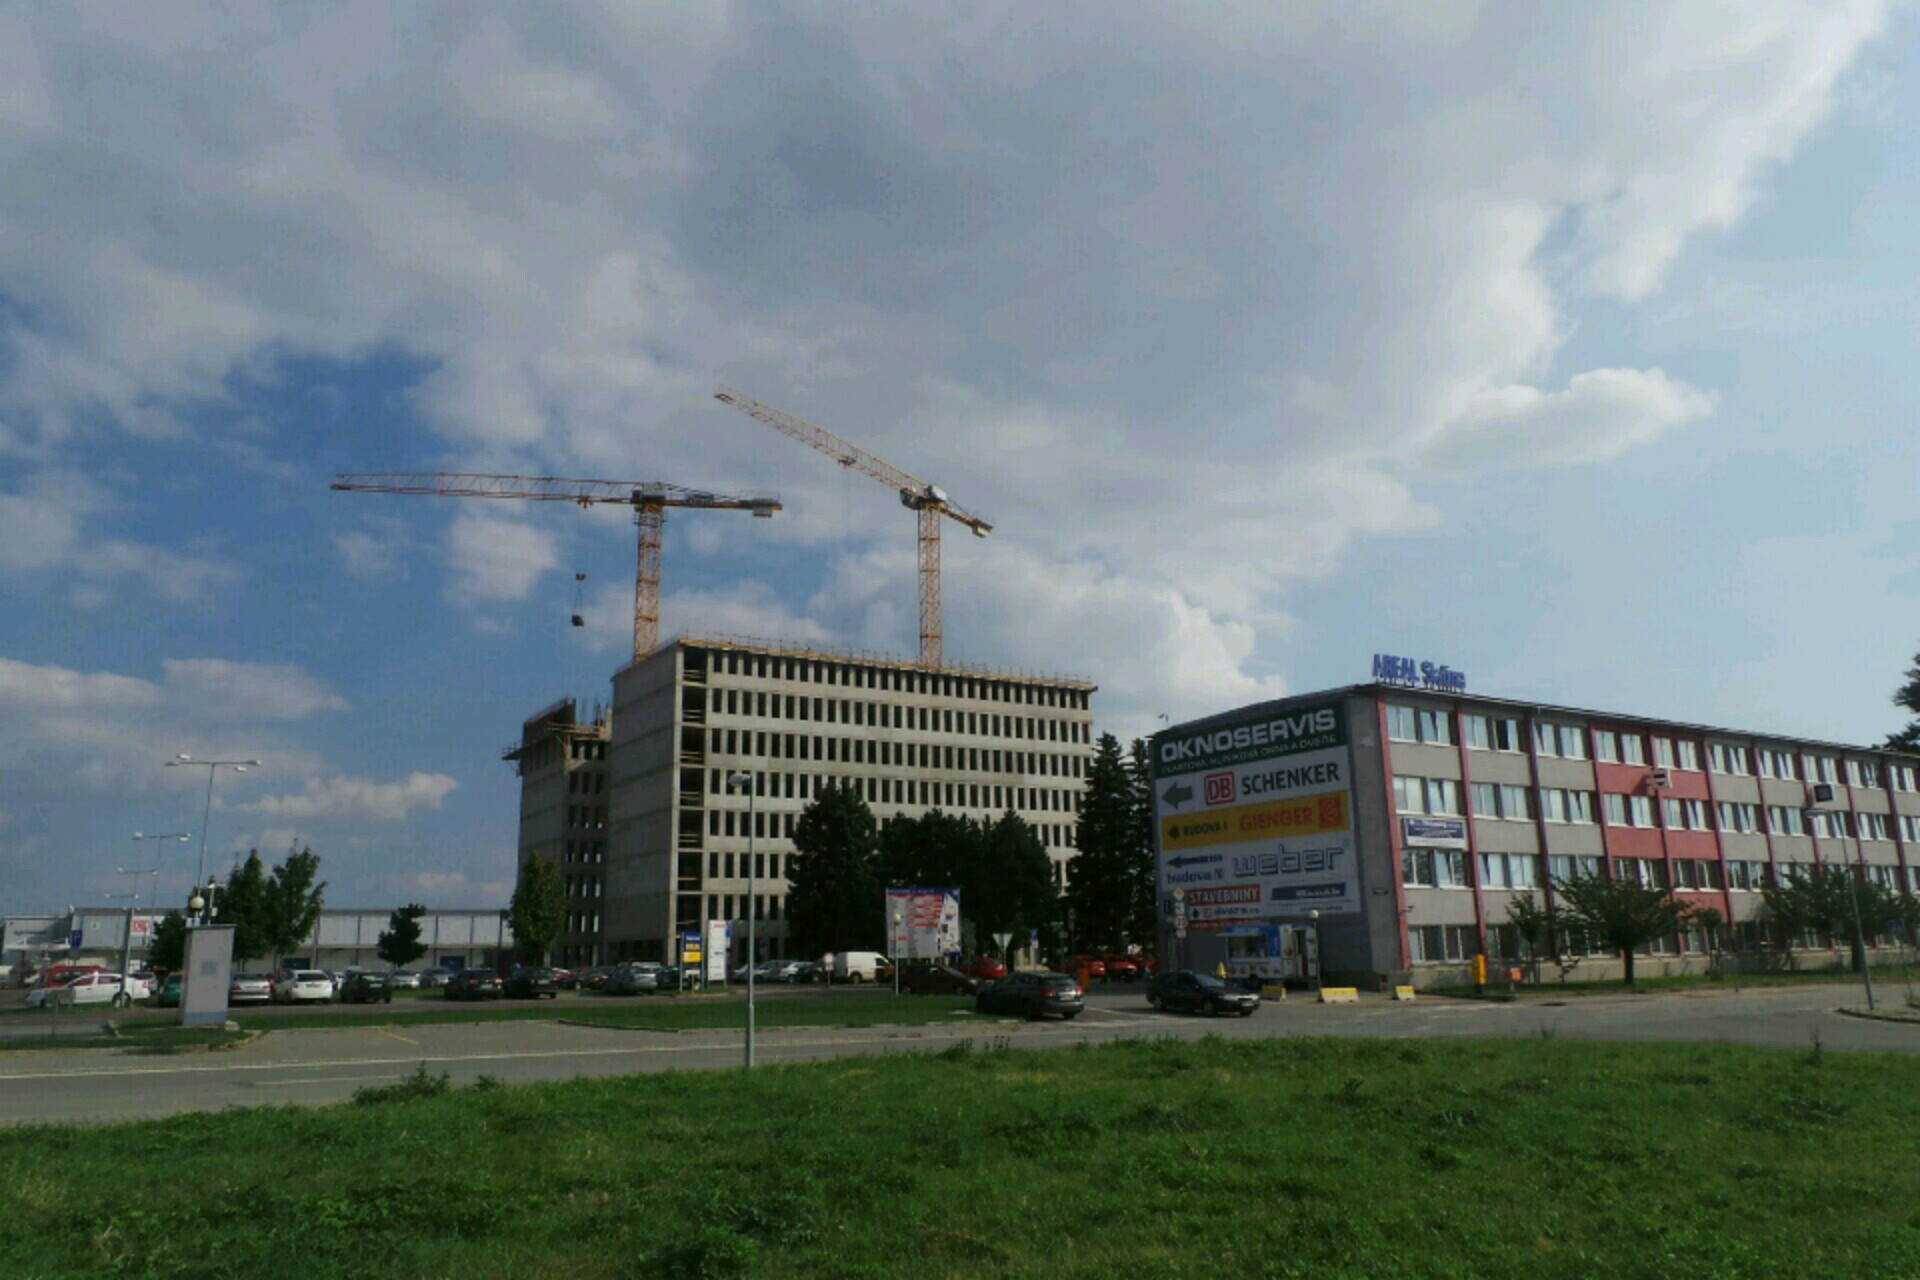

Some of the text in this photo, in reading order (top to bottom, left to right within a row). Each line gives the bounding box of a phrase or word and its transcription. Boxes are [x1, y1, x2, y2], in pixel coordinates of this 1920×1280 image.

[1161, 709, 1336, 763] OKNOSERVIS
[1207, 763, 1340, 801] DB SCHENKER
[1239, 807, 1313, 832] GIENGER
[1233, 843, 1345, 878] weber
[1167, 871, 1212, 885] budova
[1188, 887, 1258, 905] STAVEBNINY
